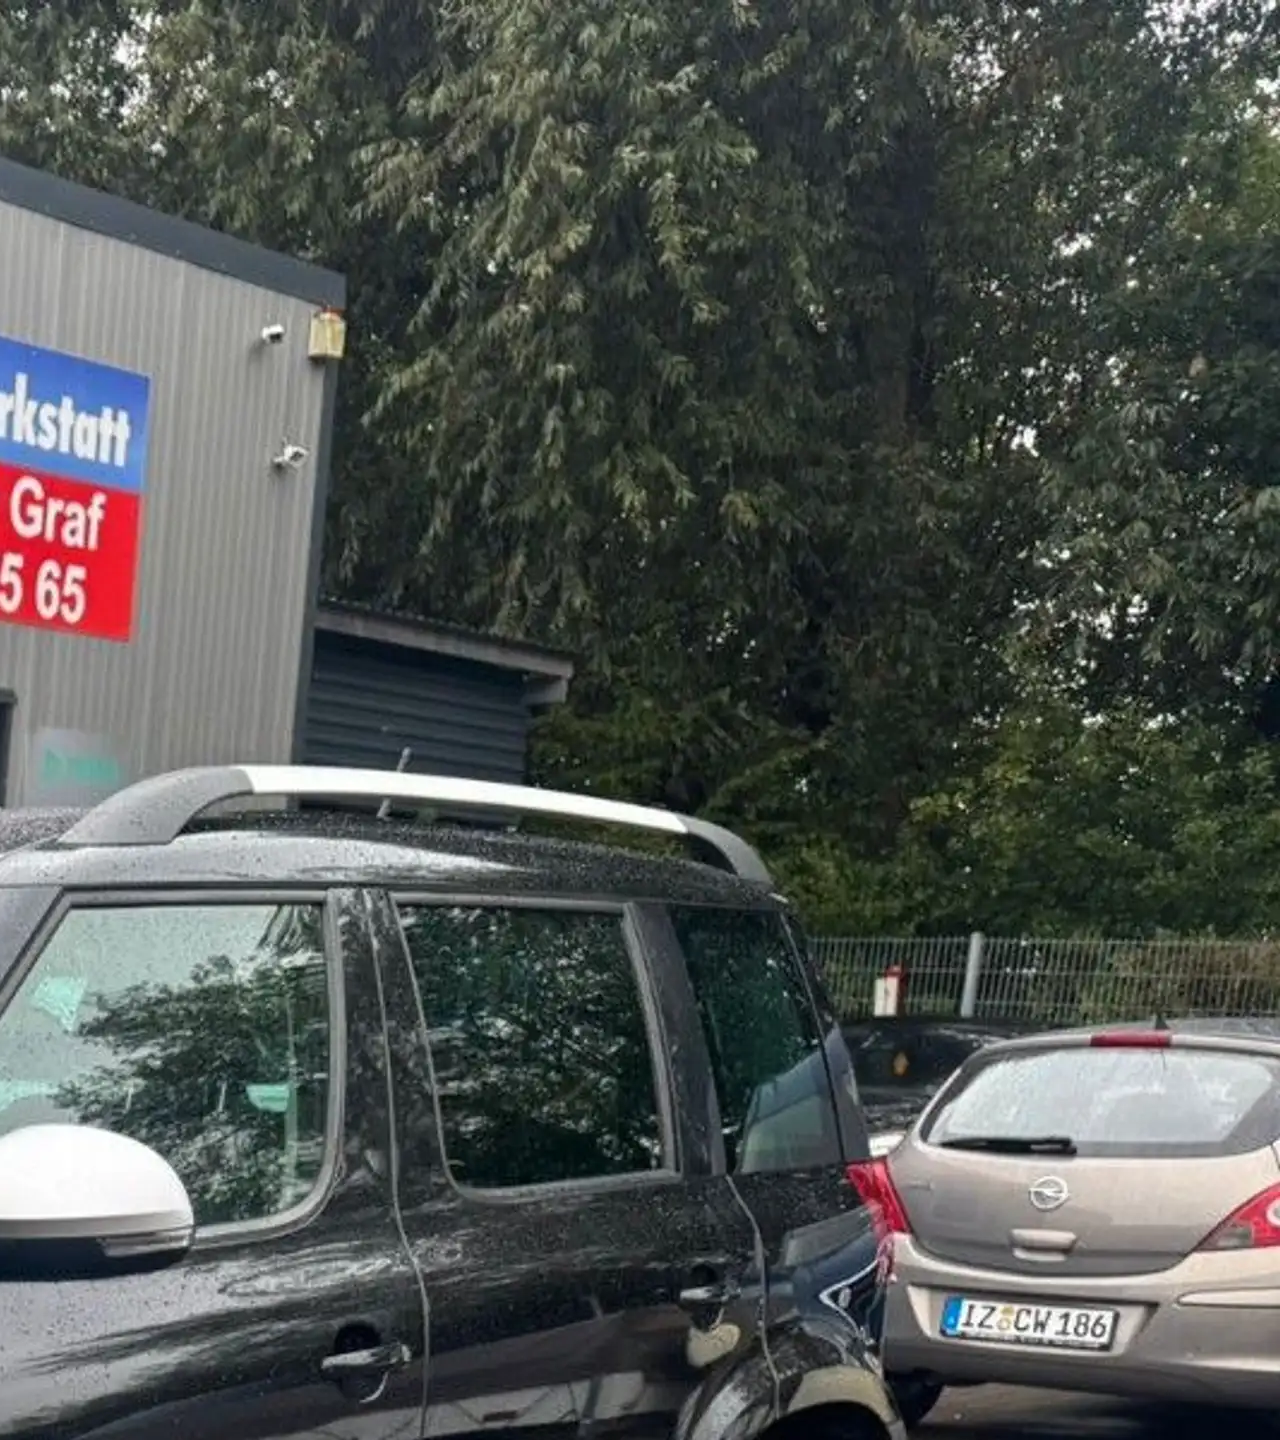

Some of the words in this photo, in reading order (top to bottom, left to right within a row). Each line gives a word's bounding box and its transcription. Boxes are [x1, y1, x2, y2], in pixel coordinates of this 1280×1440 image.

[10, 476, 106, 551] Graf
[35, 559, 87, 625] 65
[961, 1304, 997, 1329] IZ
[1013, 1308, 1051, 1334] CW
[1055, 1312, 1107, 1339] 186
